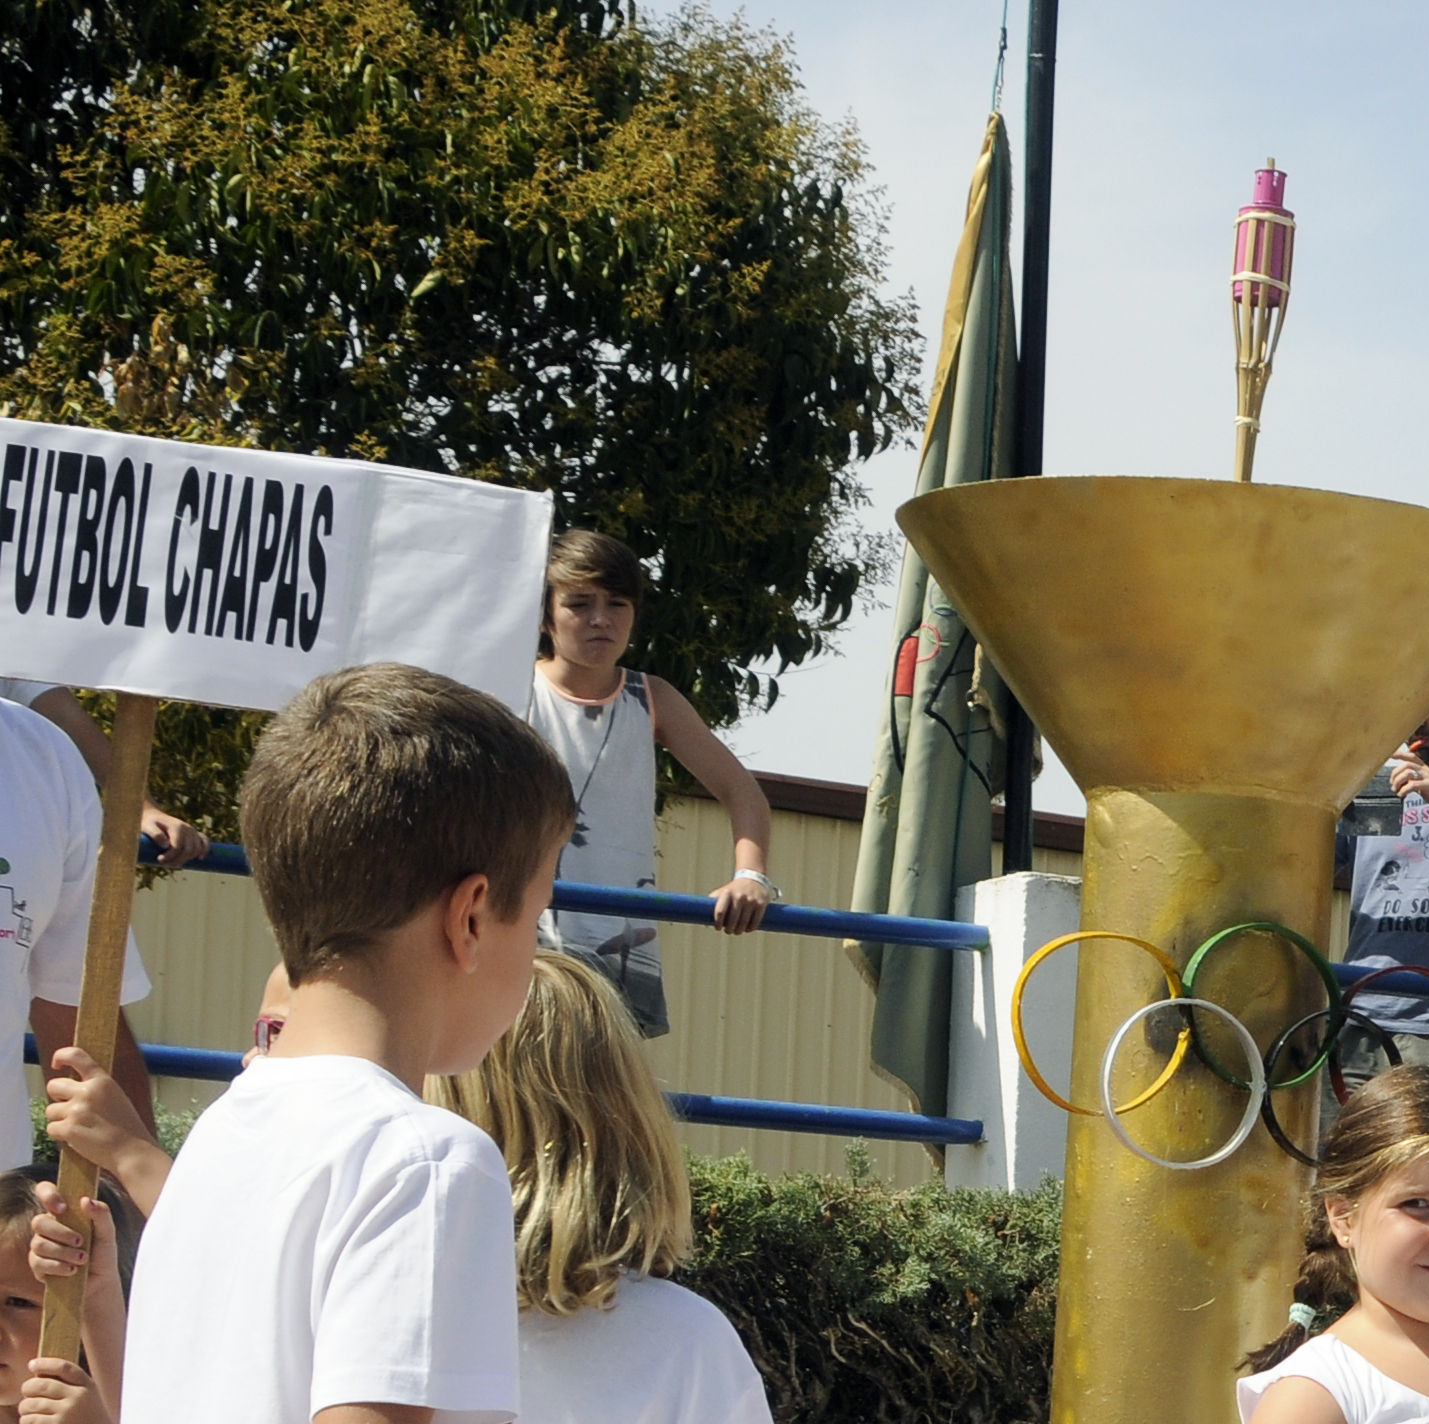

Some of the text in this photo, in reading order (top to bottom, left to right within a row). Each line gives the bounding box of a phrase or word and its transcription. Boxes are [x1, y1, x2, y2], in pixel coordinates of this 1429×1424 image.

[0, 443, 334, 653] FUTBOL CHAPAS
[1383, 898, 1402, 915] DO
